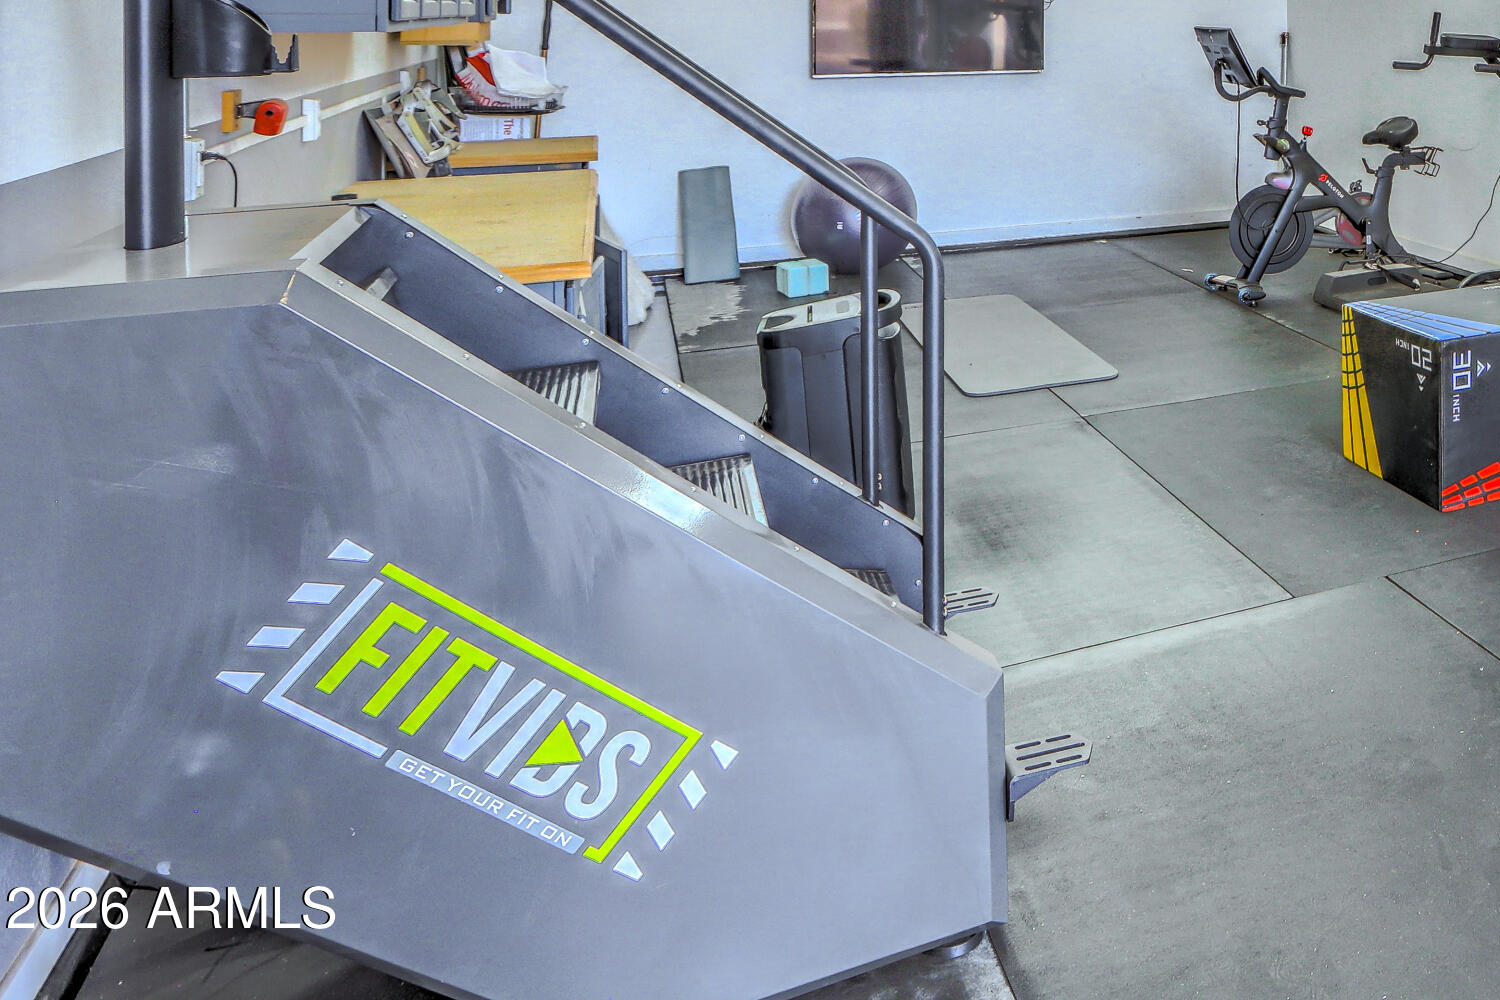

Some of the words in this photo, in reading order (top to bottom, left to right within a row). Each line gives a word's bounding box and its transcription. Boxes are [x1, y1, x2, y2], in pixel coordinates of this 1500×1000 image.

[1395, 338, 1410, 350] INCH
[1411, 344, 1432, 372] 20
[1452, 350, 1472, 391] 30
[1452, 394, 1461, 422] INCH
[315, 601, 651, 820] FITVIDS
[399, 757, 445, 785] GET
[447, 778, 504, 815] YOUR
[506, 808, 540, 830] FIT
[540, 825, 573, 847] ON
